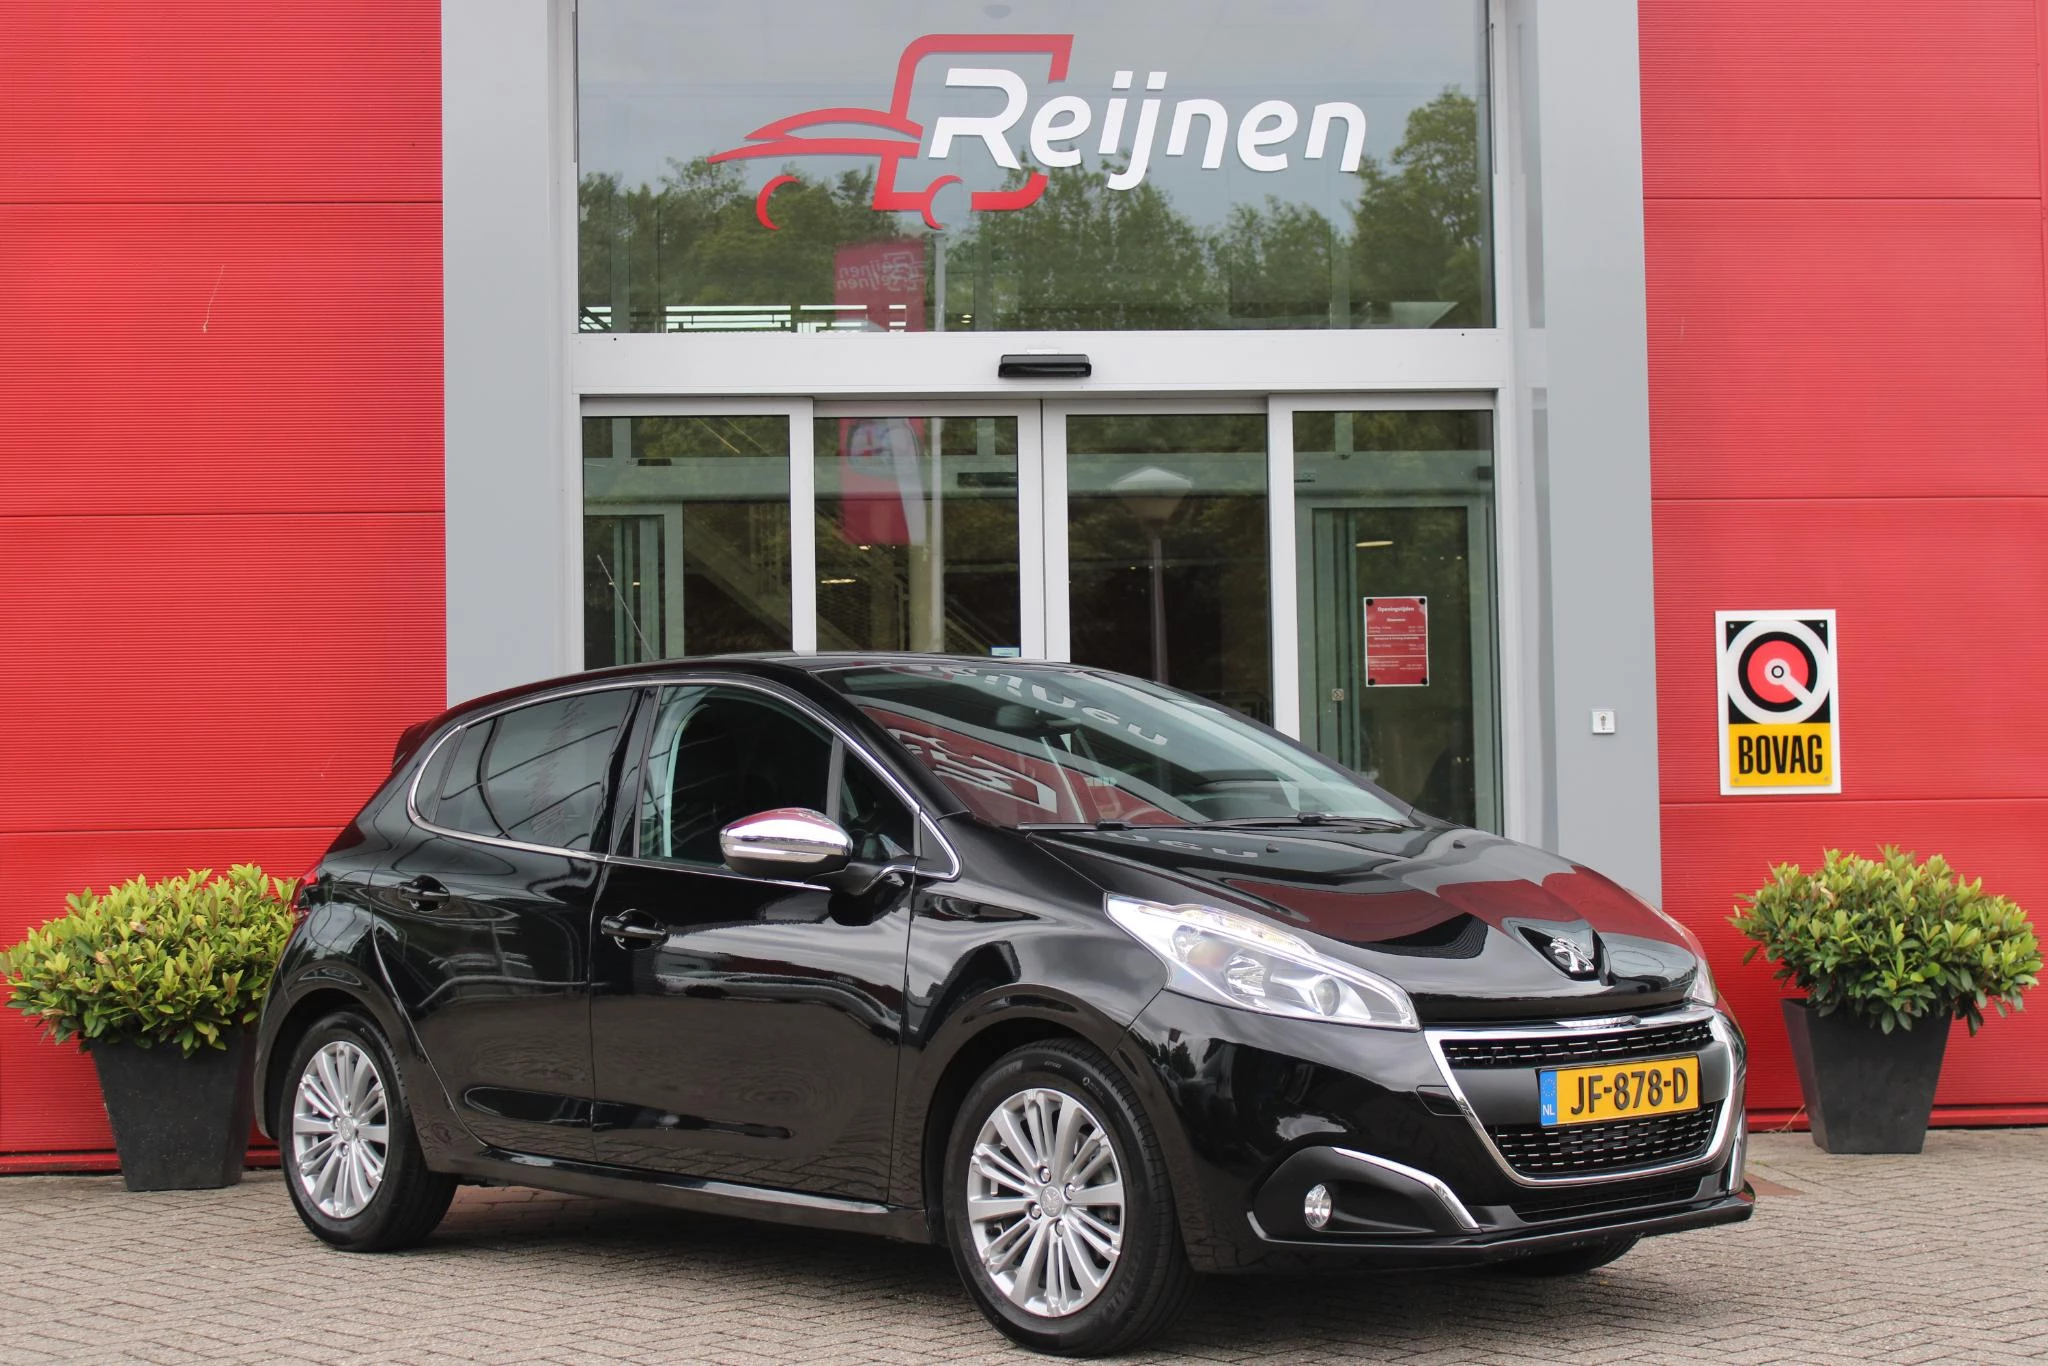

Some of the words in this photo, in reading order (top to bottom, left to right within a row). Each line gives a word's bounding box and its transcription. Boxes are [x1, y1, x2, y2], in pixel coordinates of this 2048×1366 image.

[928, 67, 1367, 191] Reijnen
[1738, 734, 1823, 775] BOVAG
[1542, 1103, 1556, 1116] NL
[1571, 1067, 1689, 1116] JF-878-D
